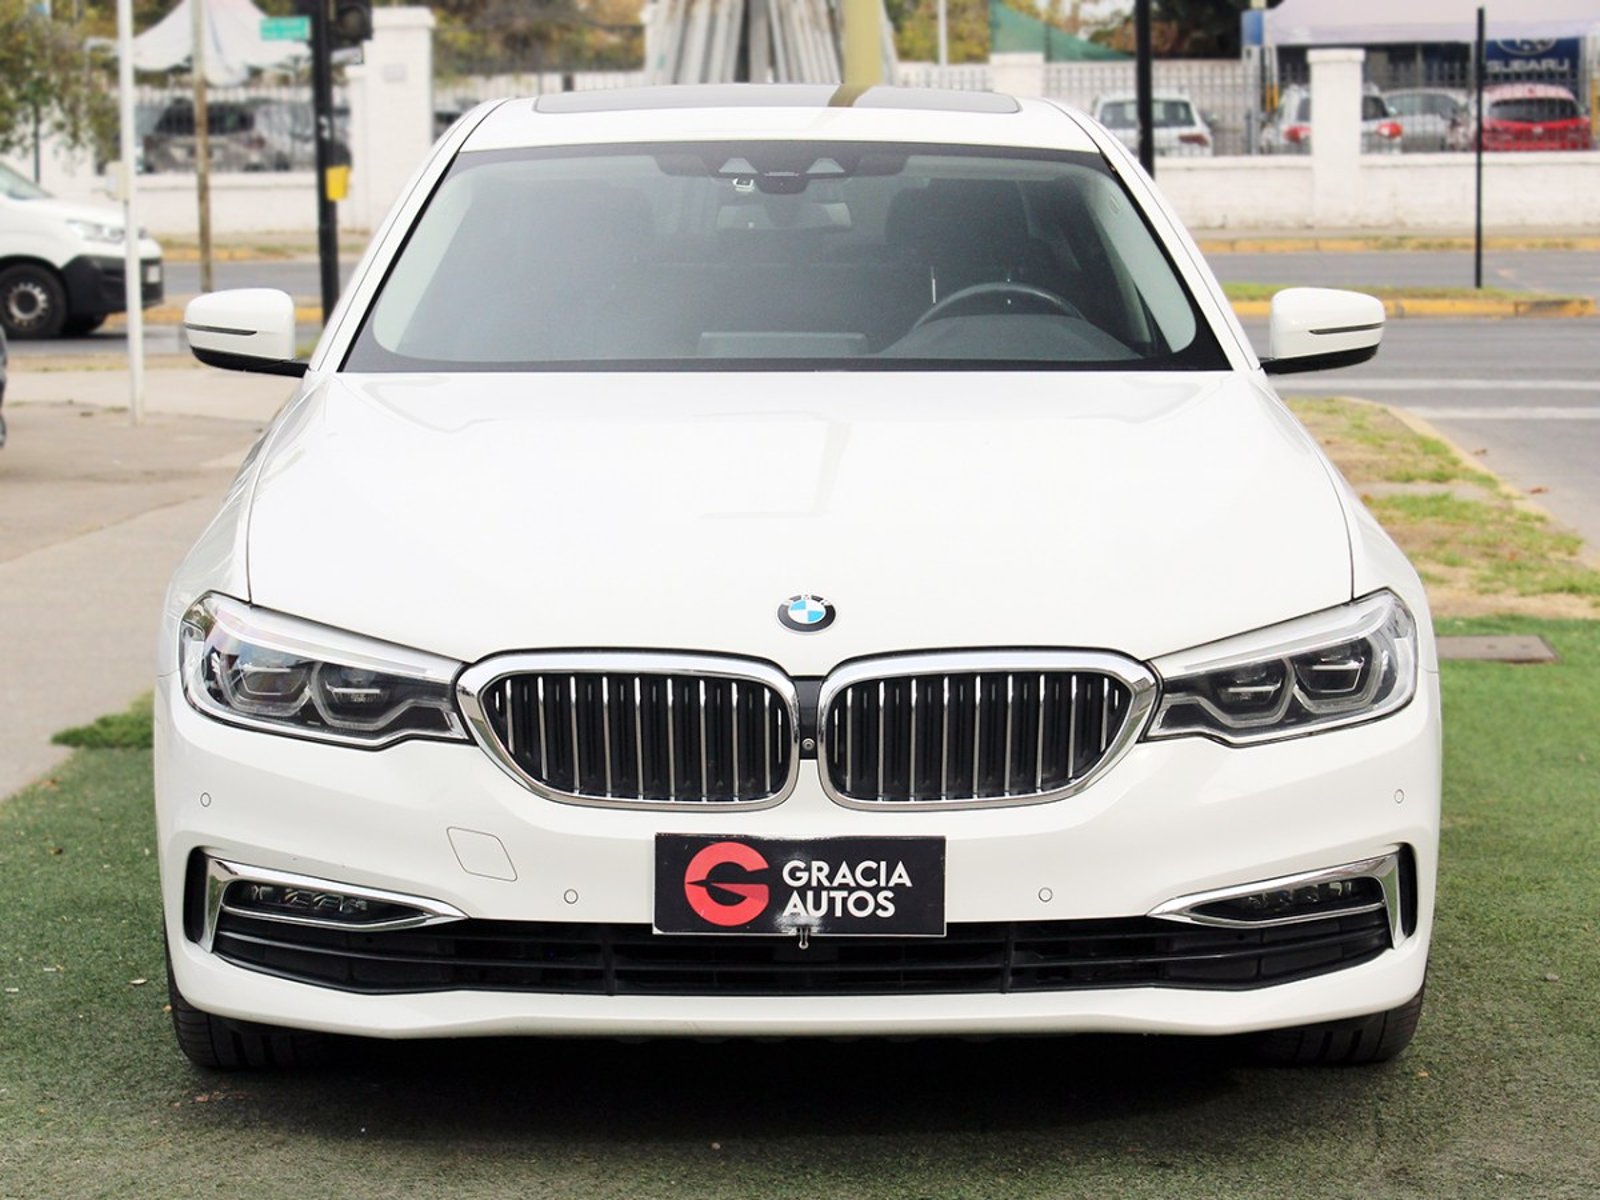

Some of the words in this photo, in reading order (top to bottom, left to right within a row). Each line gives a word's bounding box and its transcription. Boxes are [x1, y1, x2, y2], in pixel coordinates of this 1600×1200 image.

[1486, 58, 1570, 73] SUBARU
[782, 860, 913, 888] GRACIA
[782, 889, 896, 919] AUTOS
